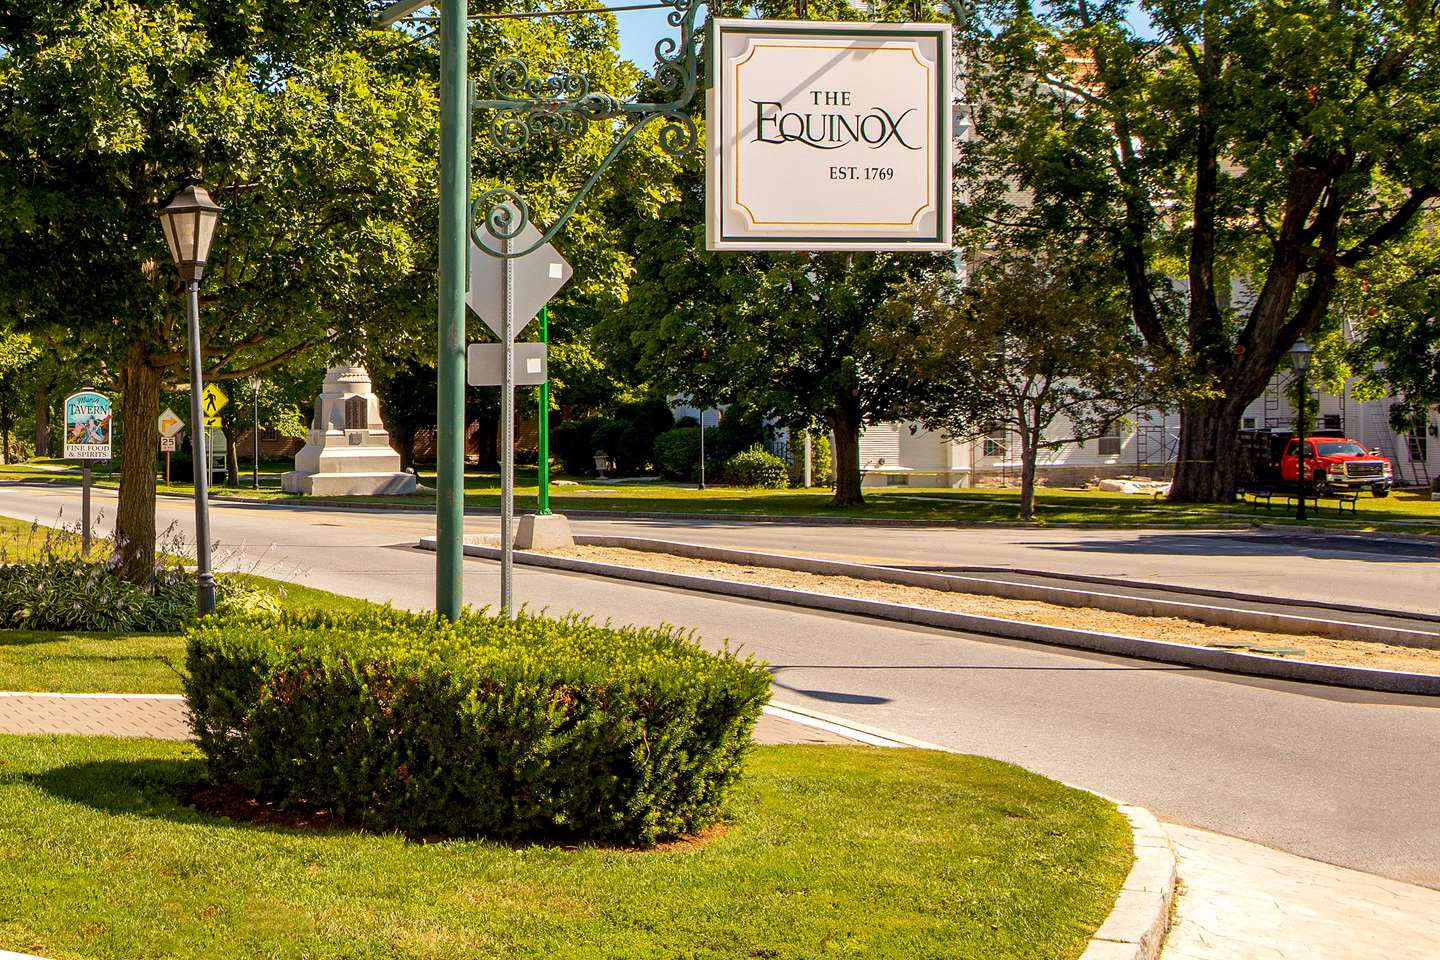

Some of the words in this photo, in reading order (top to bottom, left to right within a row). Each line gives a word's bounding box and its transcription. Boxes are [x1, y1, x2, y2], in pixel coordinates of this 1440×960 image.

[810, 91, 851, 106] THE
[748, 99, 923, 150] EQUINOX
[829, 166, 860, 180] EST.
[864, 167, 894, 181] 1769
[68, 404, 108, 415] TAVERN
[162, 438, 174, 446] 25
